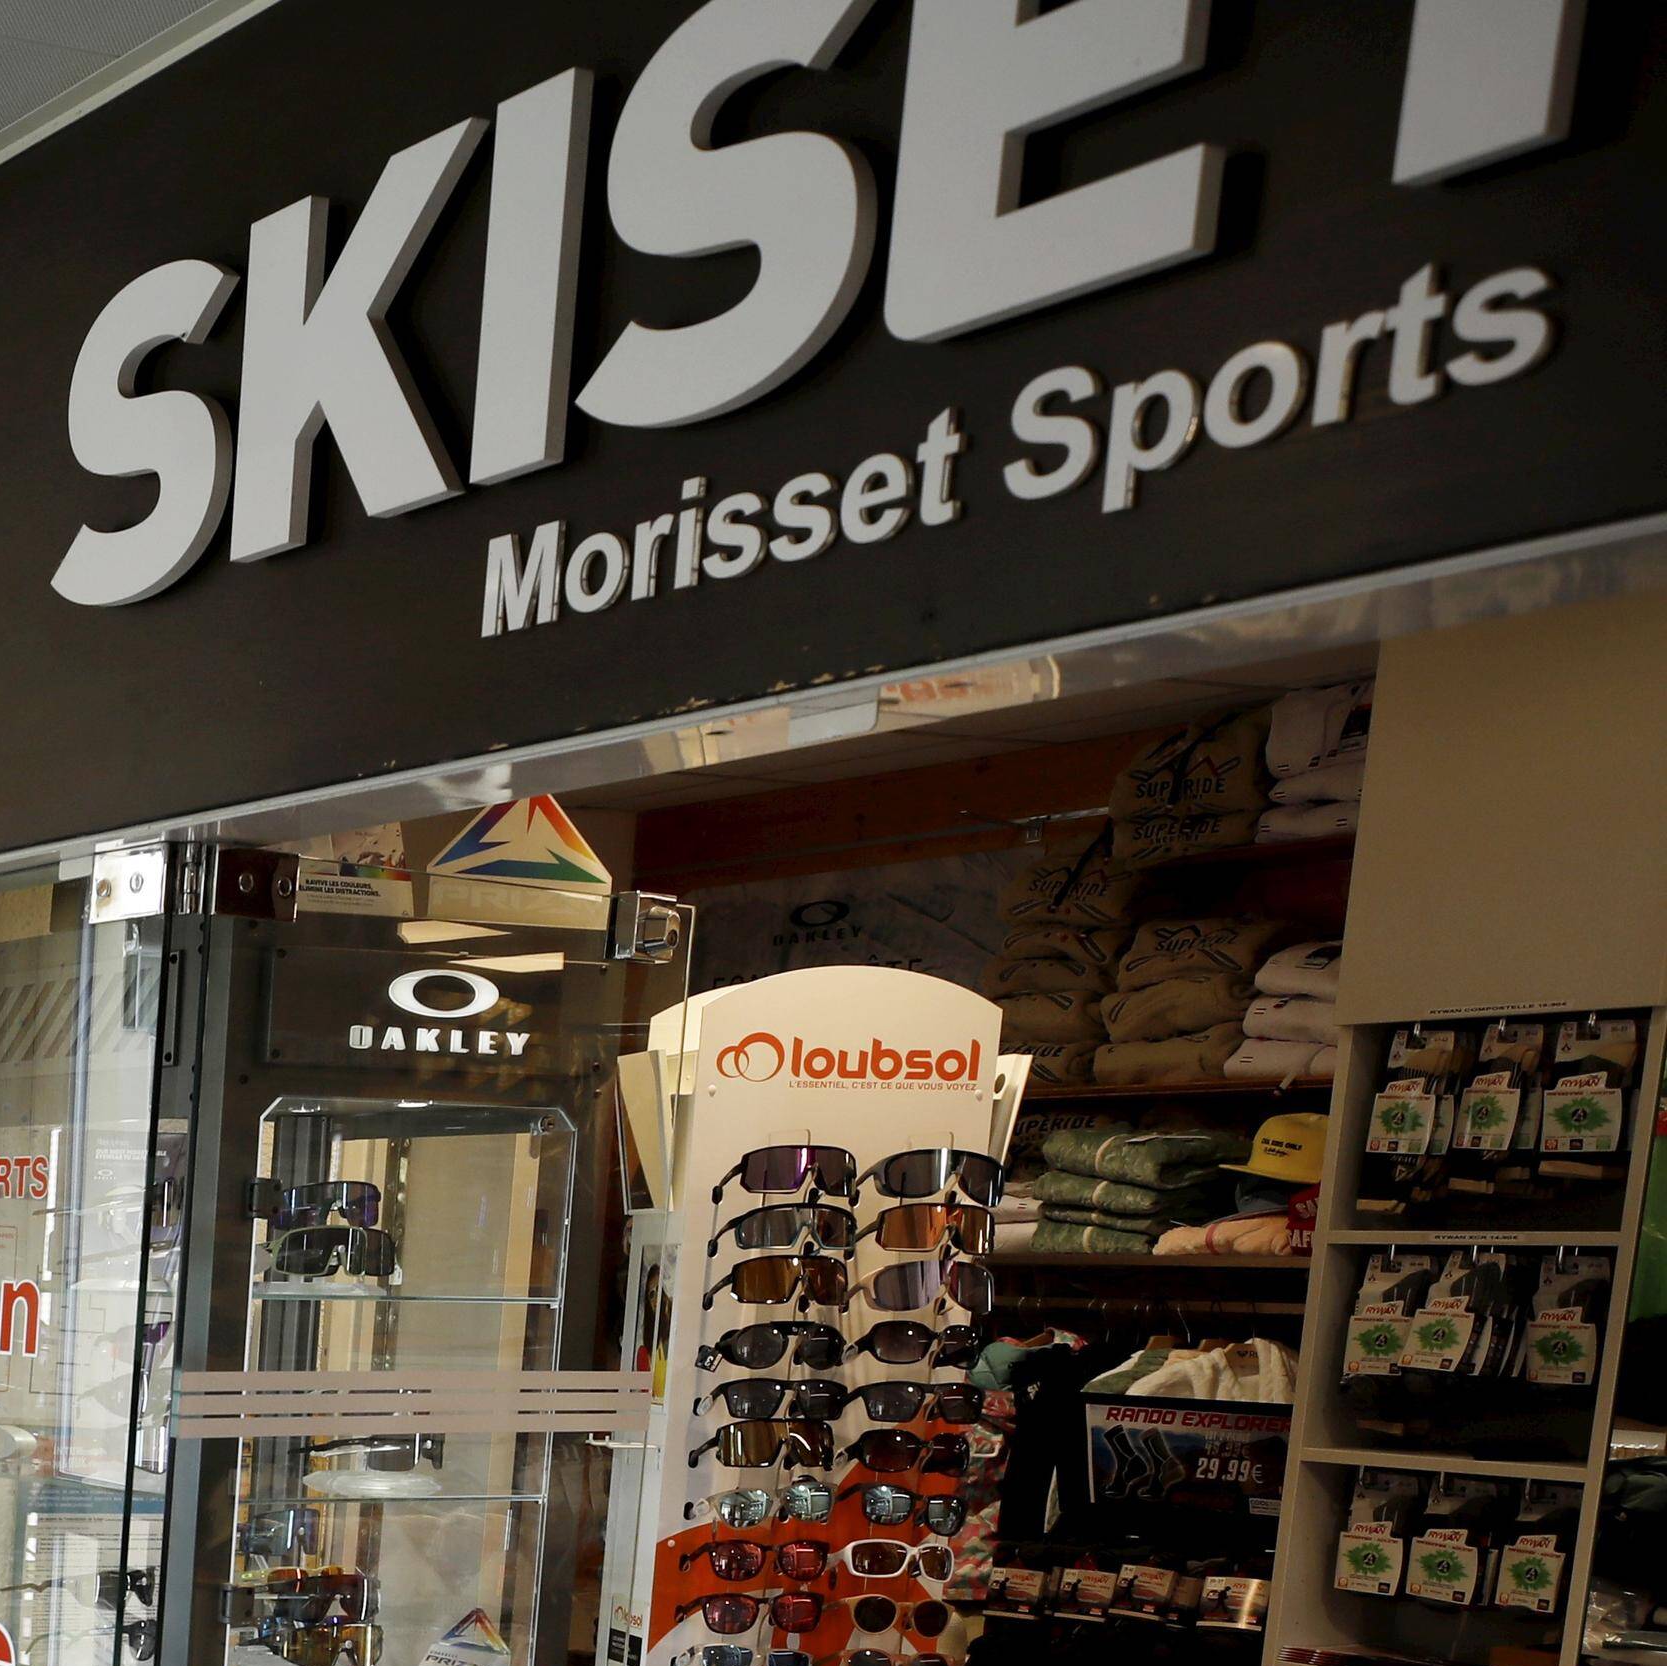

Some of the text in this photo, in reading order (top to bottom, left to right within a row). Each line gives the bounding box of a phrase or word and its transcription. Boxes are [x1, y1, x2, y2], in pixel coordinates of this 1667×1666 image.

[480, 262, 1557, 639] Morisset Sports
[1135, 777, 1227, 798] SUPRIDE
[1029, 877, 1109, 896] SUPRIDE
[772, 926, 862, 947] OAKLEY
[349, 1024, 531, 1056] OAKLEY
[791, 1036, 982, 1082] loubsol
[789, 1080, 978, 1092] L'ESSENTIEL, C'EST CE QUE VOUS VOYEZ
[1105, 1406, 1292, 1433] RANDO EXPLORER
[1195, 1457, 1265, 1485] 29.99€
